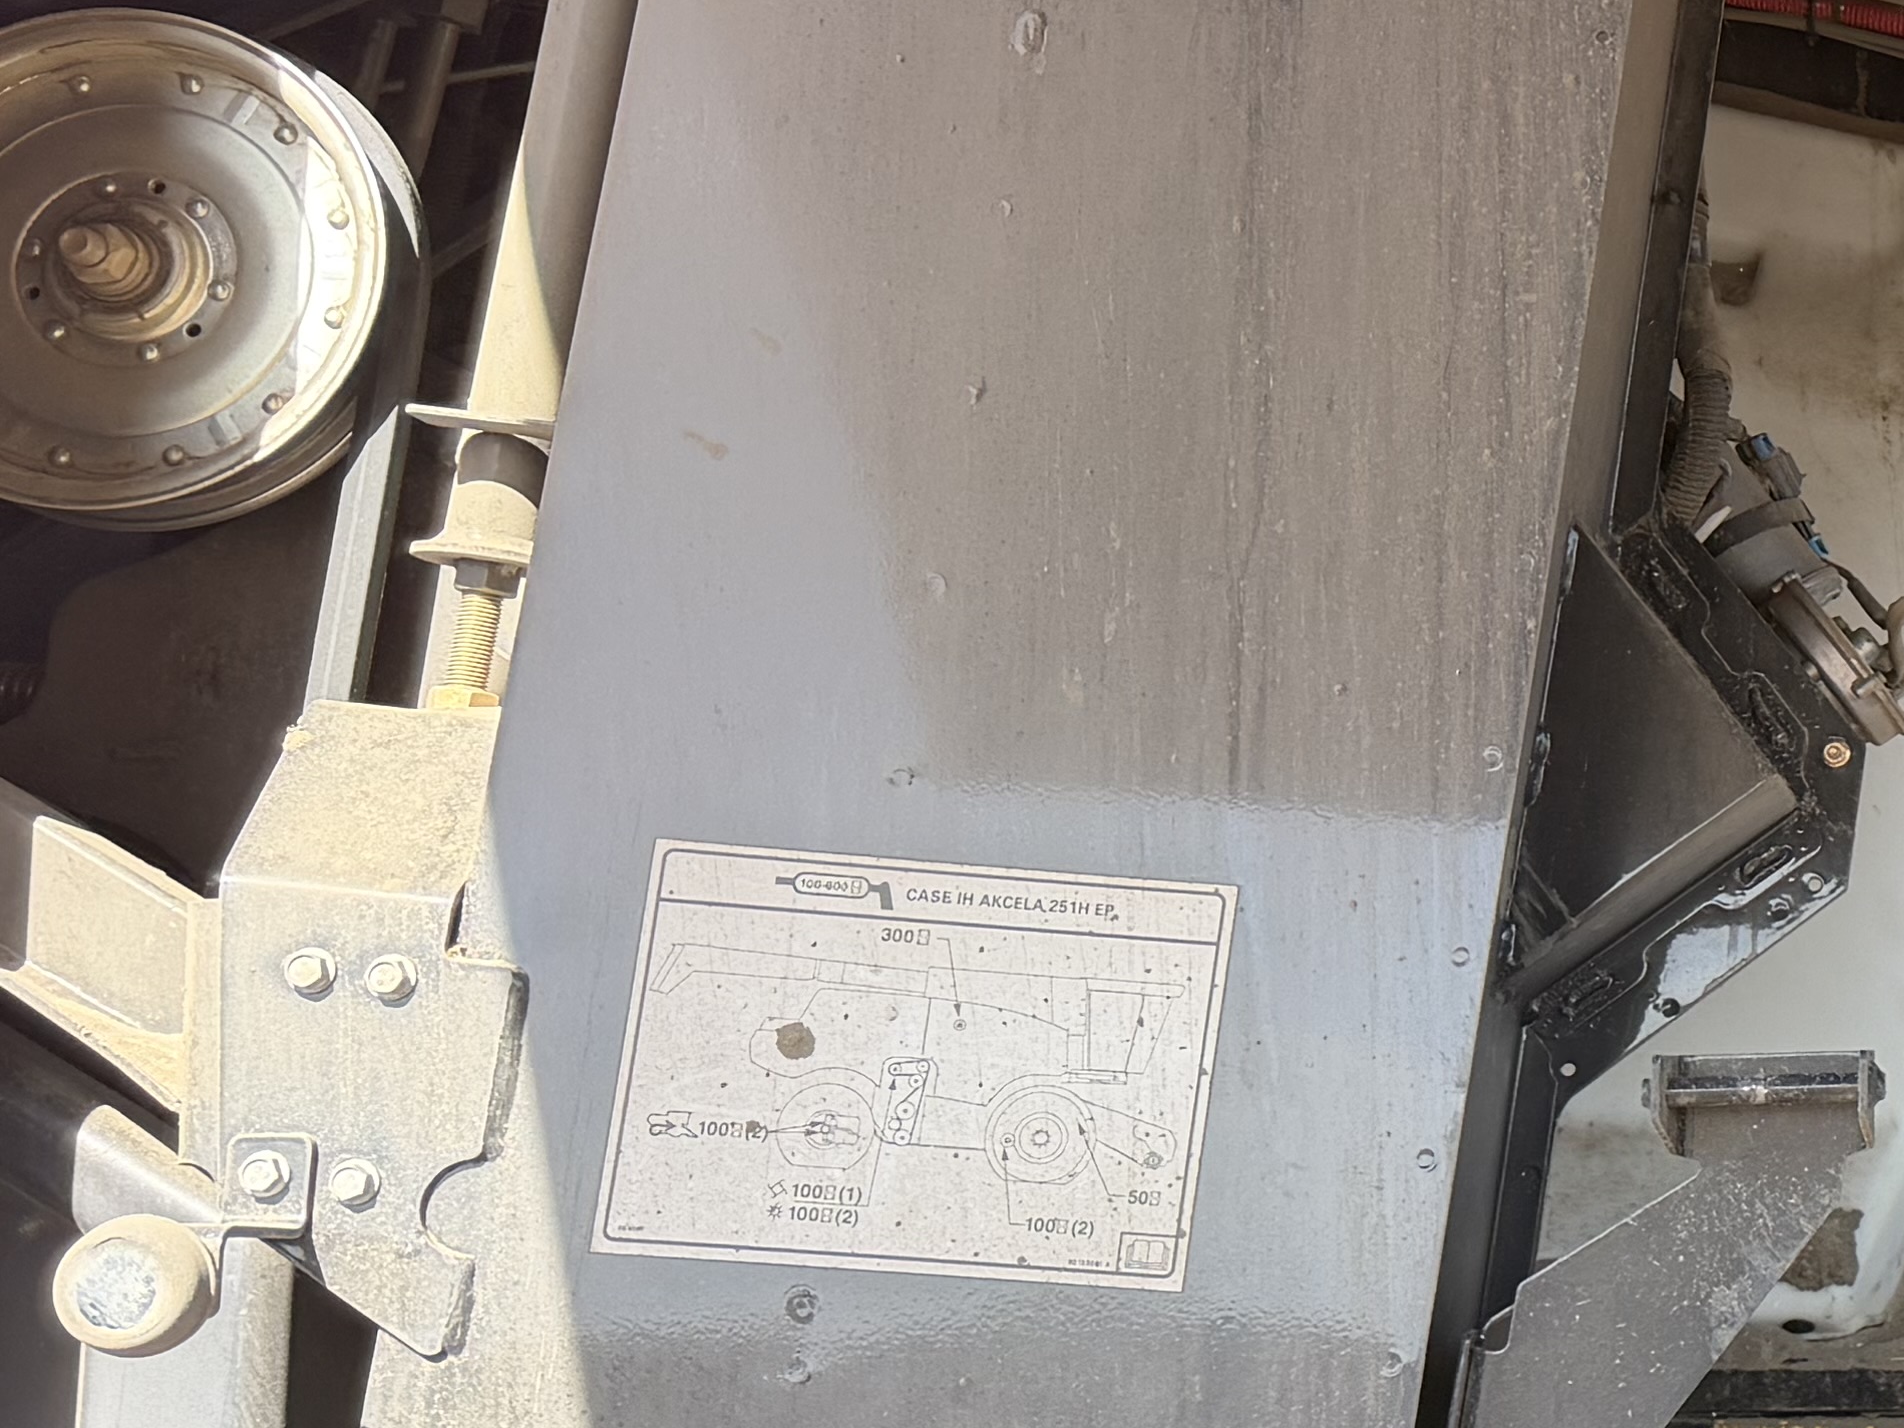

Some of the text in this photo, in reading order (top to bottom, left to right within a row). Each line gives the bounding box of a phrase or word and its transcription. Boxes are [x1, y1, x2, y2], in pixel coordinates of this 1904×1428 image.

[906, 888, 1115, 917] CASE IH AKCELA 251H EP
[881, 927, 914, 943] 300
[699, 1121, 730, 1137] 100
[791, 1183, 862, 1206] 100 (1)
[1128, 1190, 1149, 1205] 50
[789, 1206, 859, 1228] 100 (2)
[1026, 1217, 1095, 1240] 100 (2)
